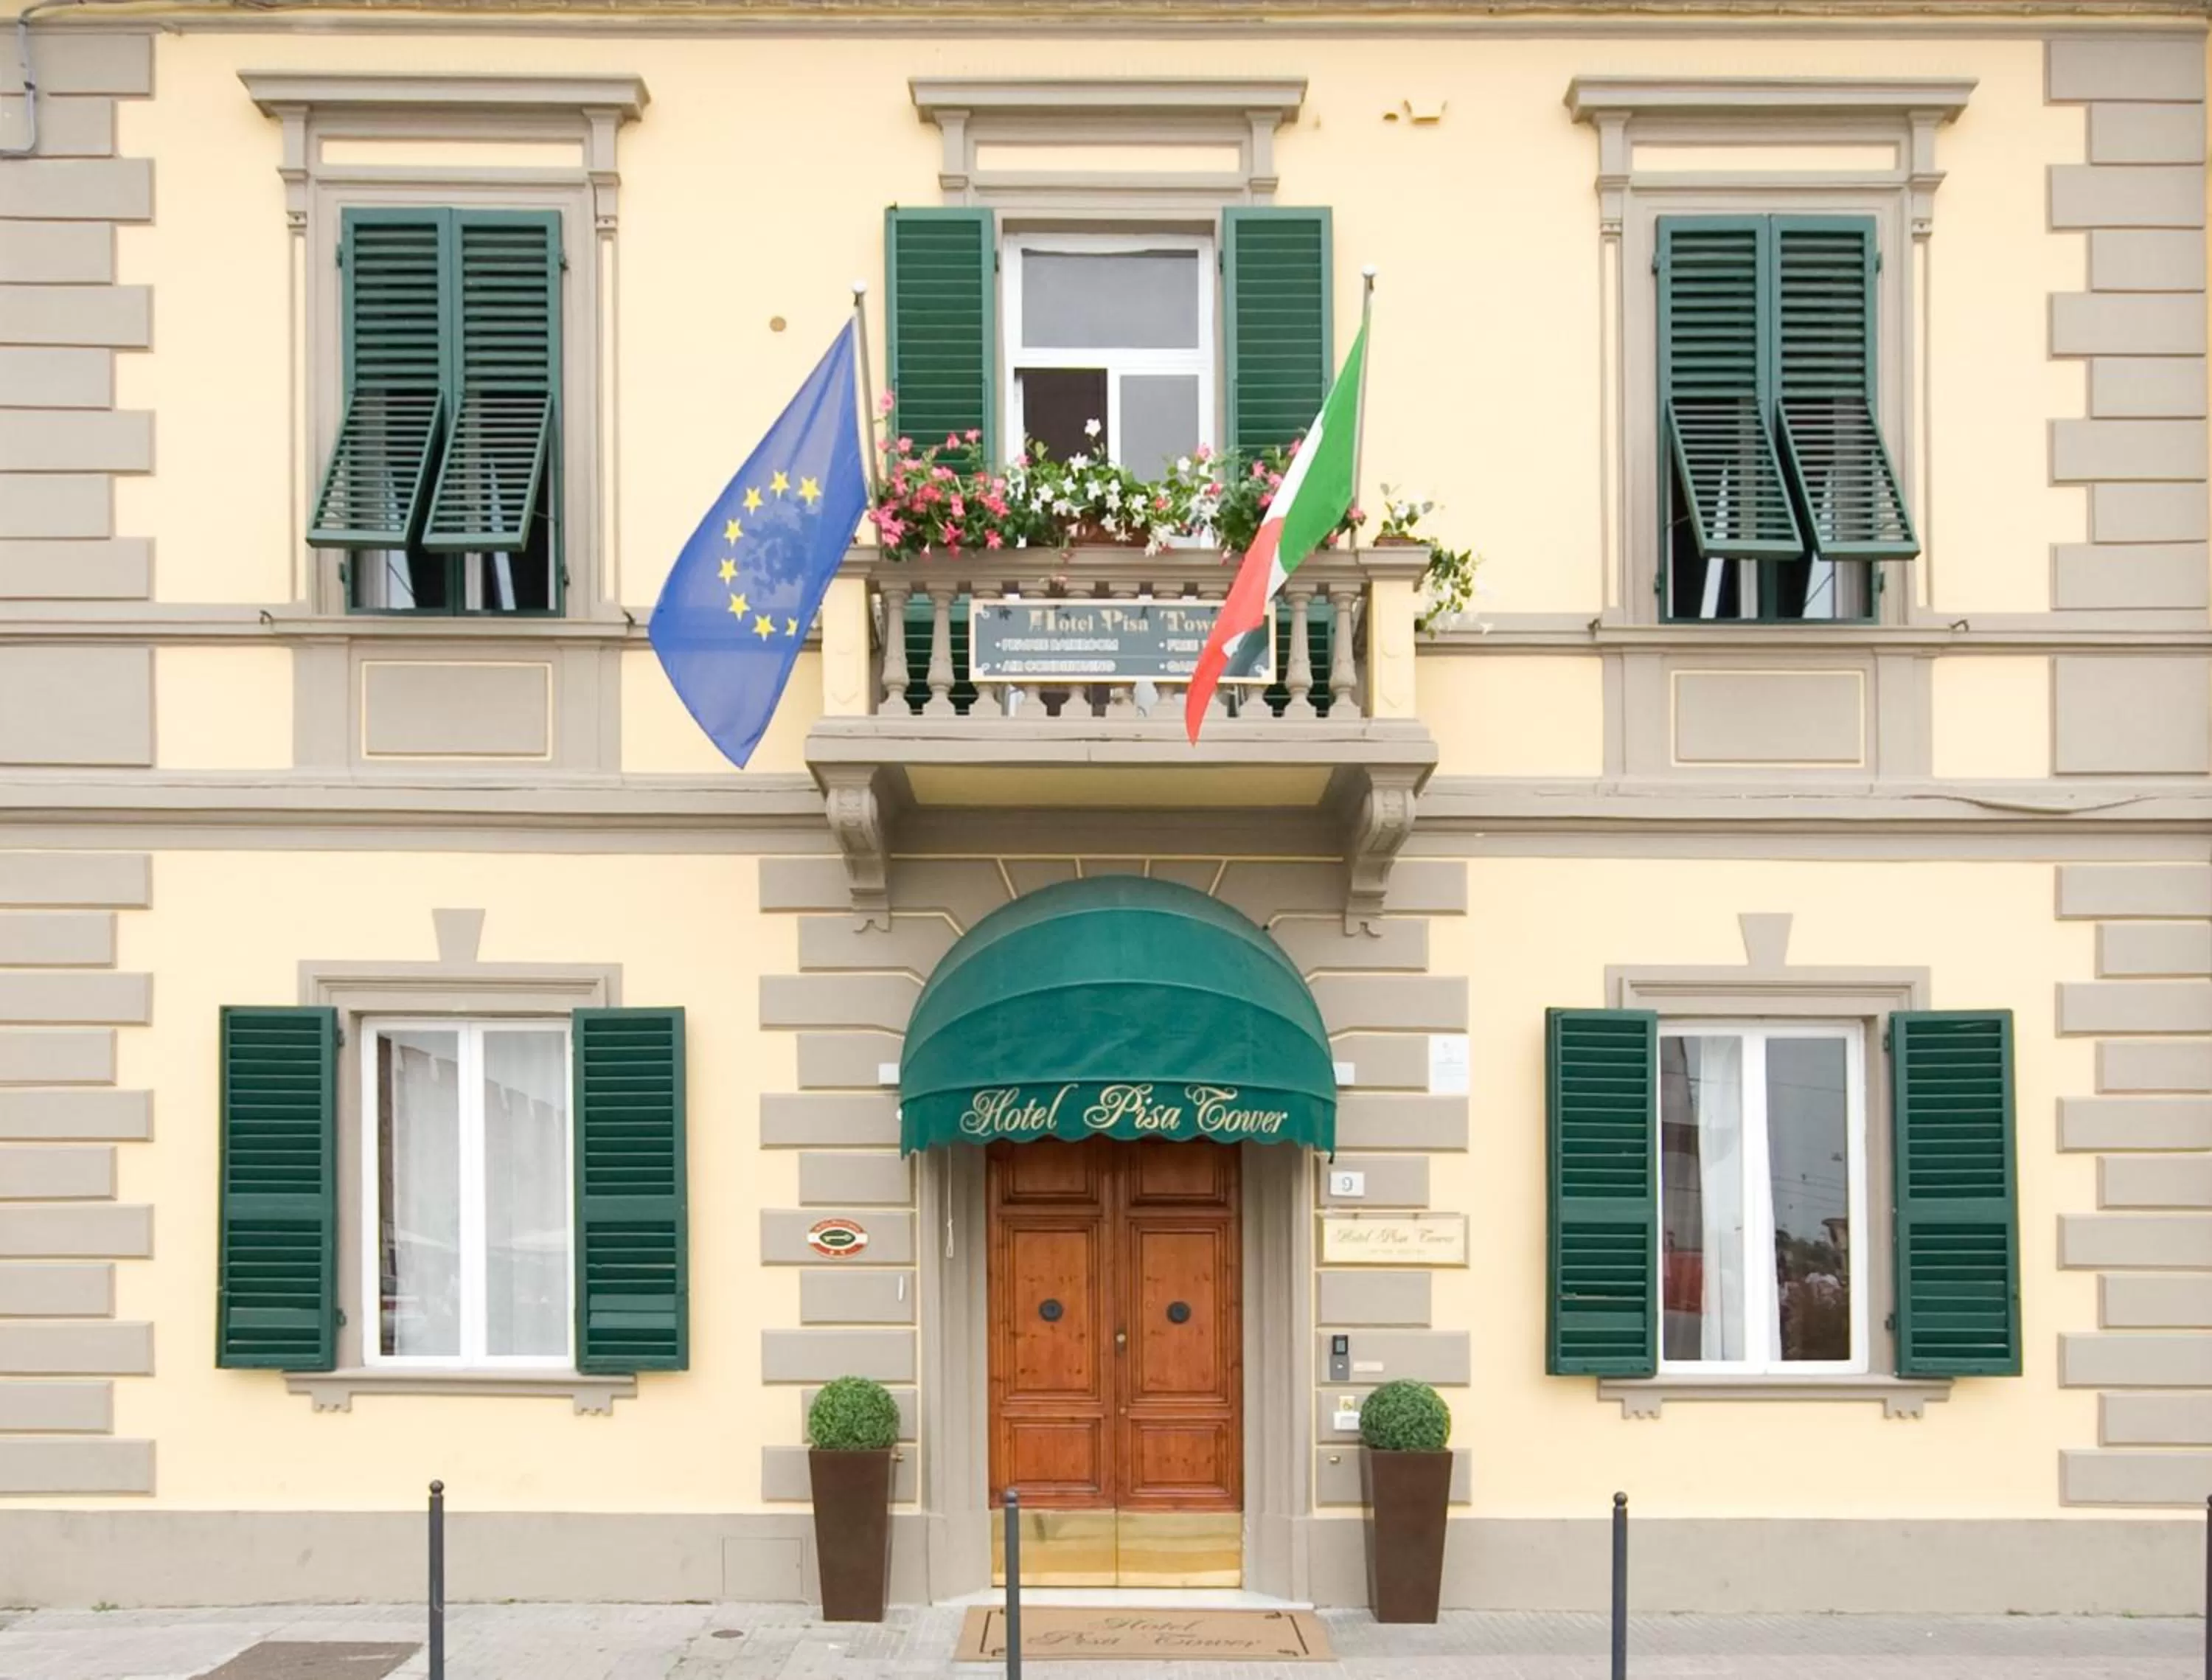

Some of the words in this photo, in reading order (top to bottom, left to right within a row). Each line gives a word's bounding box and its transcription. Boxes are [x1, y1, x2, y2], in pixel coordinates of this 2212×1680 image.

[1029, 609, 1094, 632] Hotel
[1099, 609, 1149, 632] Pisa
[1158, 610, 1217, 632] Towe
[960, 1083, 1078, 1135] Hotel
[1083, 1083, 1181, 1131] Pisa
[1185, 1084, 1288, 1134] Tower
[1341, 1176, 1353, 1192] 9
[1333, 1228, 1373, 1244] Hotel
[1095, 1617, 1203, 1631] Hotel
[1027, 1630, 1121, 1646] Pisa
[1147, 1632, 1262, 1648] Tower
